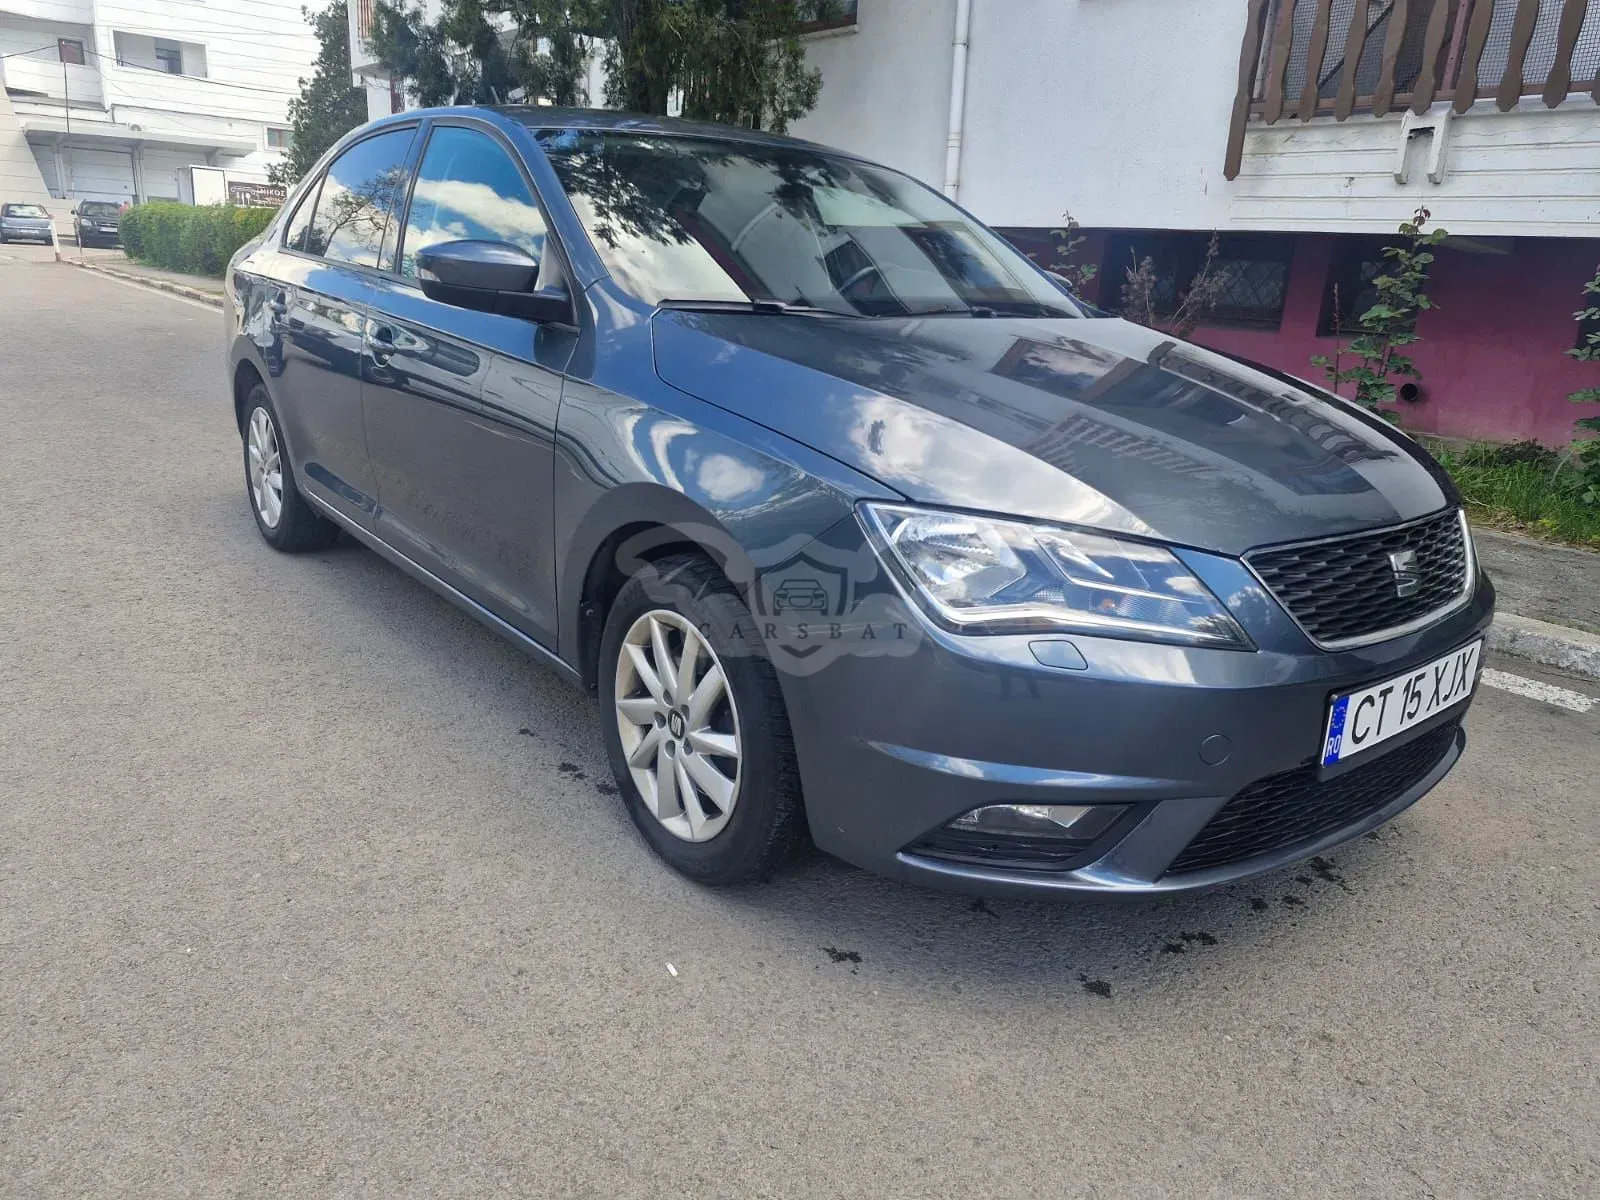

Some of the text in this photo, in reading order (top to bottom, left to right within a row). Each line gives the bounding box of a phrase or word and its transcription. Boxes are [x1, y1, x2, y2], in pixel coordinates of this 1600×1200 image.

[1351, 647, 1475, 745] CT 15 XJX
[1325, 734, 1342, 757] RO
